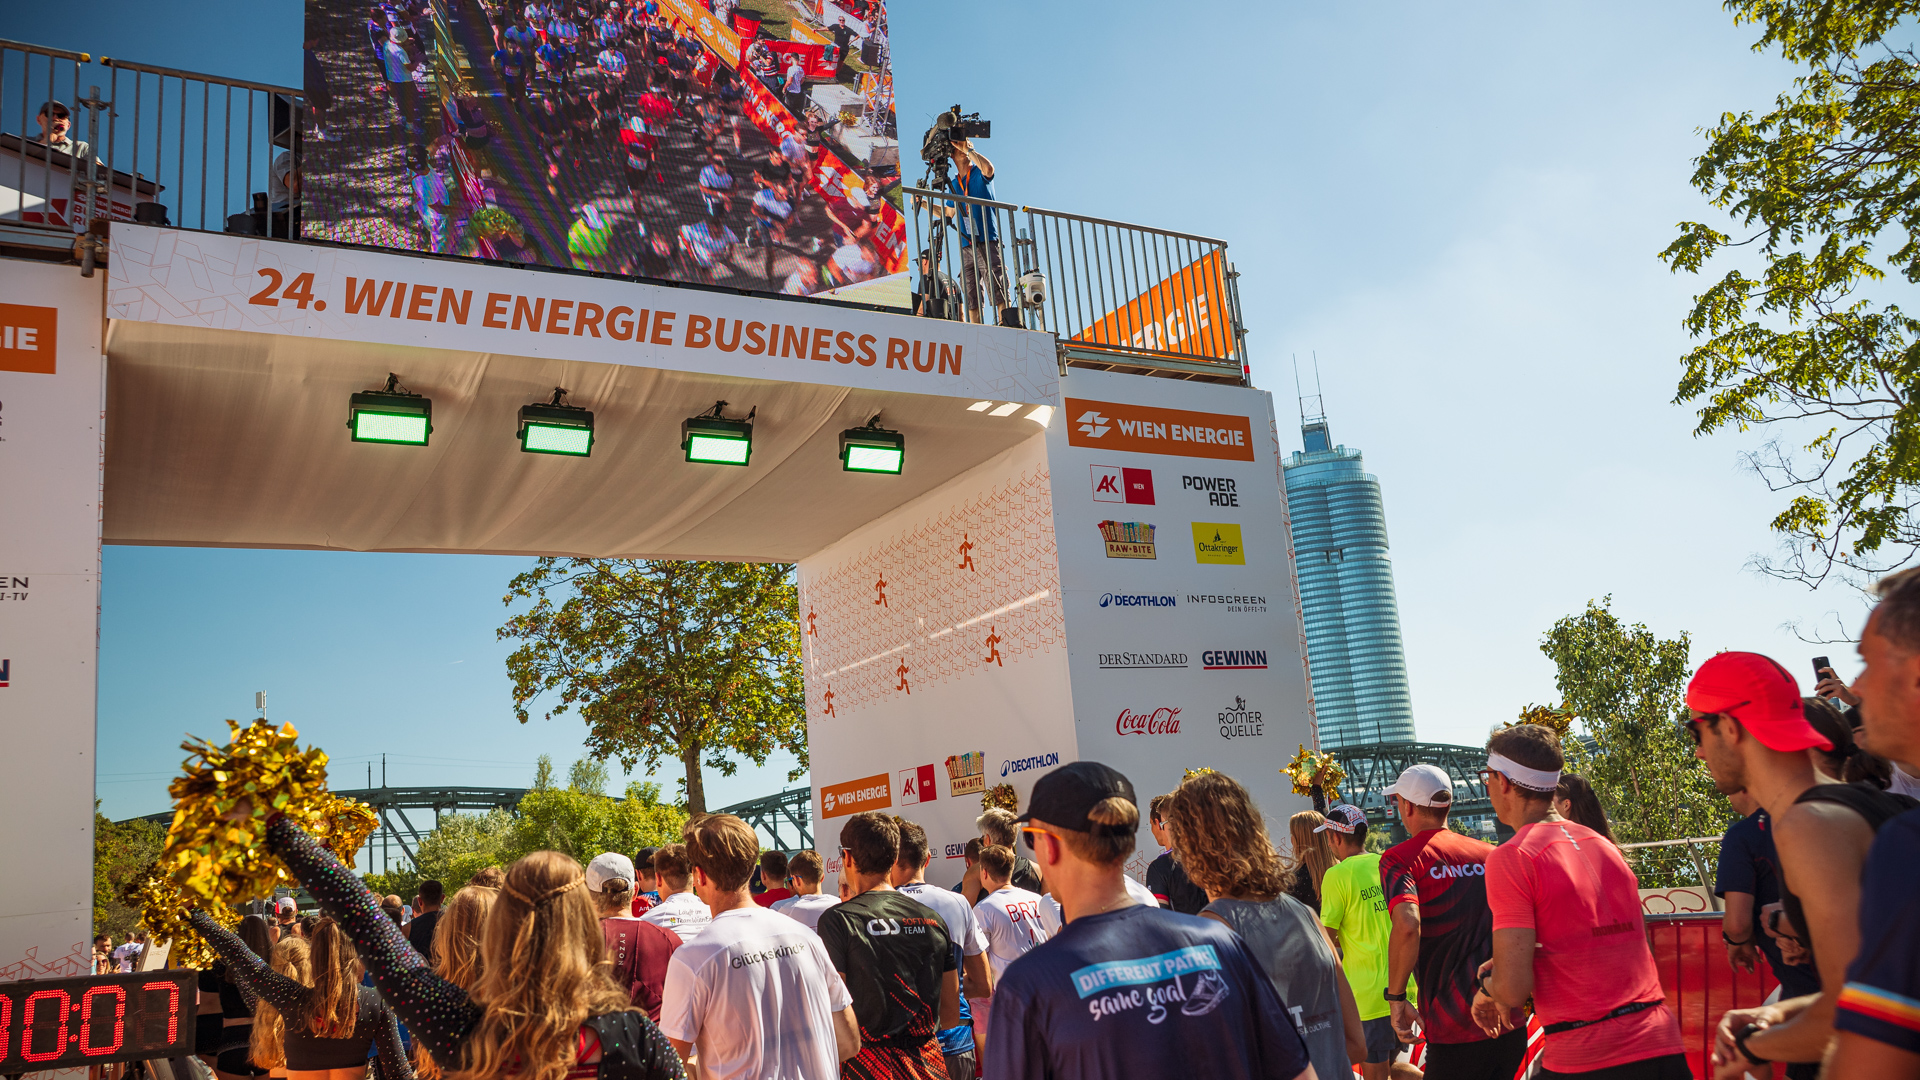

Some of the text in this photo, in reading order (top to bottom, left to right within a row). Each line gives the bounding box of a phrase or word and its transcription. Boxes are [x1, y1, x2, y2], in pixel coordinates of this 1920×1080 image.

[248, 267, 963, 376] 24. WIEN ENERGIE BUSINESS RUN
[0, 325, 38, 351] IE
[1116, 418, 1245, 447] WIEN ENERGIE
[1096, 474, 1145, 494] AK WIEN
[1182, 475, 1237, 492] POWER
[1209, 492, 1239, 507] ADE
[1198, 541, 1239, 555] Ottakringer
[1114, 595, 1176, 607] DECATHLON
[1186, 594, 1266, 605] INFOSCREEN
[1243, 605, 1267, 613] ÖFFI-TV
[1201, 650, 1268, 666] GEWINN
[1115, 707, 1183, 736] Coca-Cola
[1219, 724, 1263, 740] QUELLE
[1011, 752, 1059, 773] DECATHLON
[837, 784, 888, 806] WIEN ENERGIE
[902, 777, 916, 797] AK
[1429, 863, 1486, 880] CANCO
[866, 917, 901, 936] CSS
[903, 926, 926, 935] TEAM
[618, 932, 626, 966] RYZON
[1078, 961, 1162, 992] DIFFERENT
[1089, 974, 1188, 1025] same goal
[0, 980, 180, 1063] 0:07
